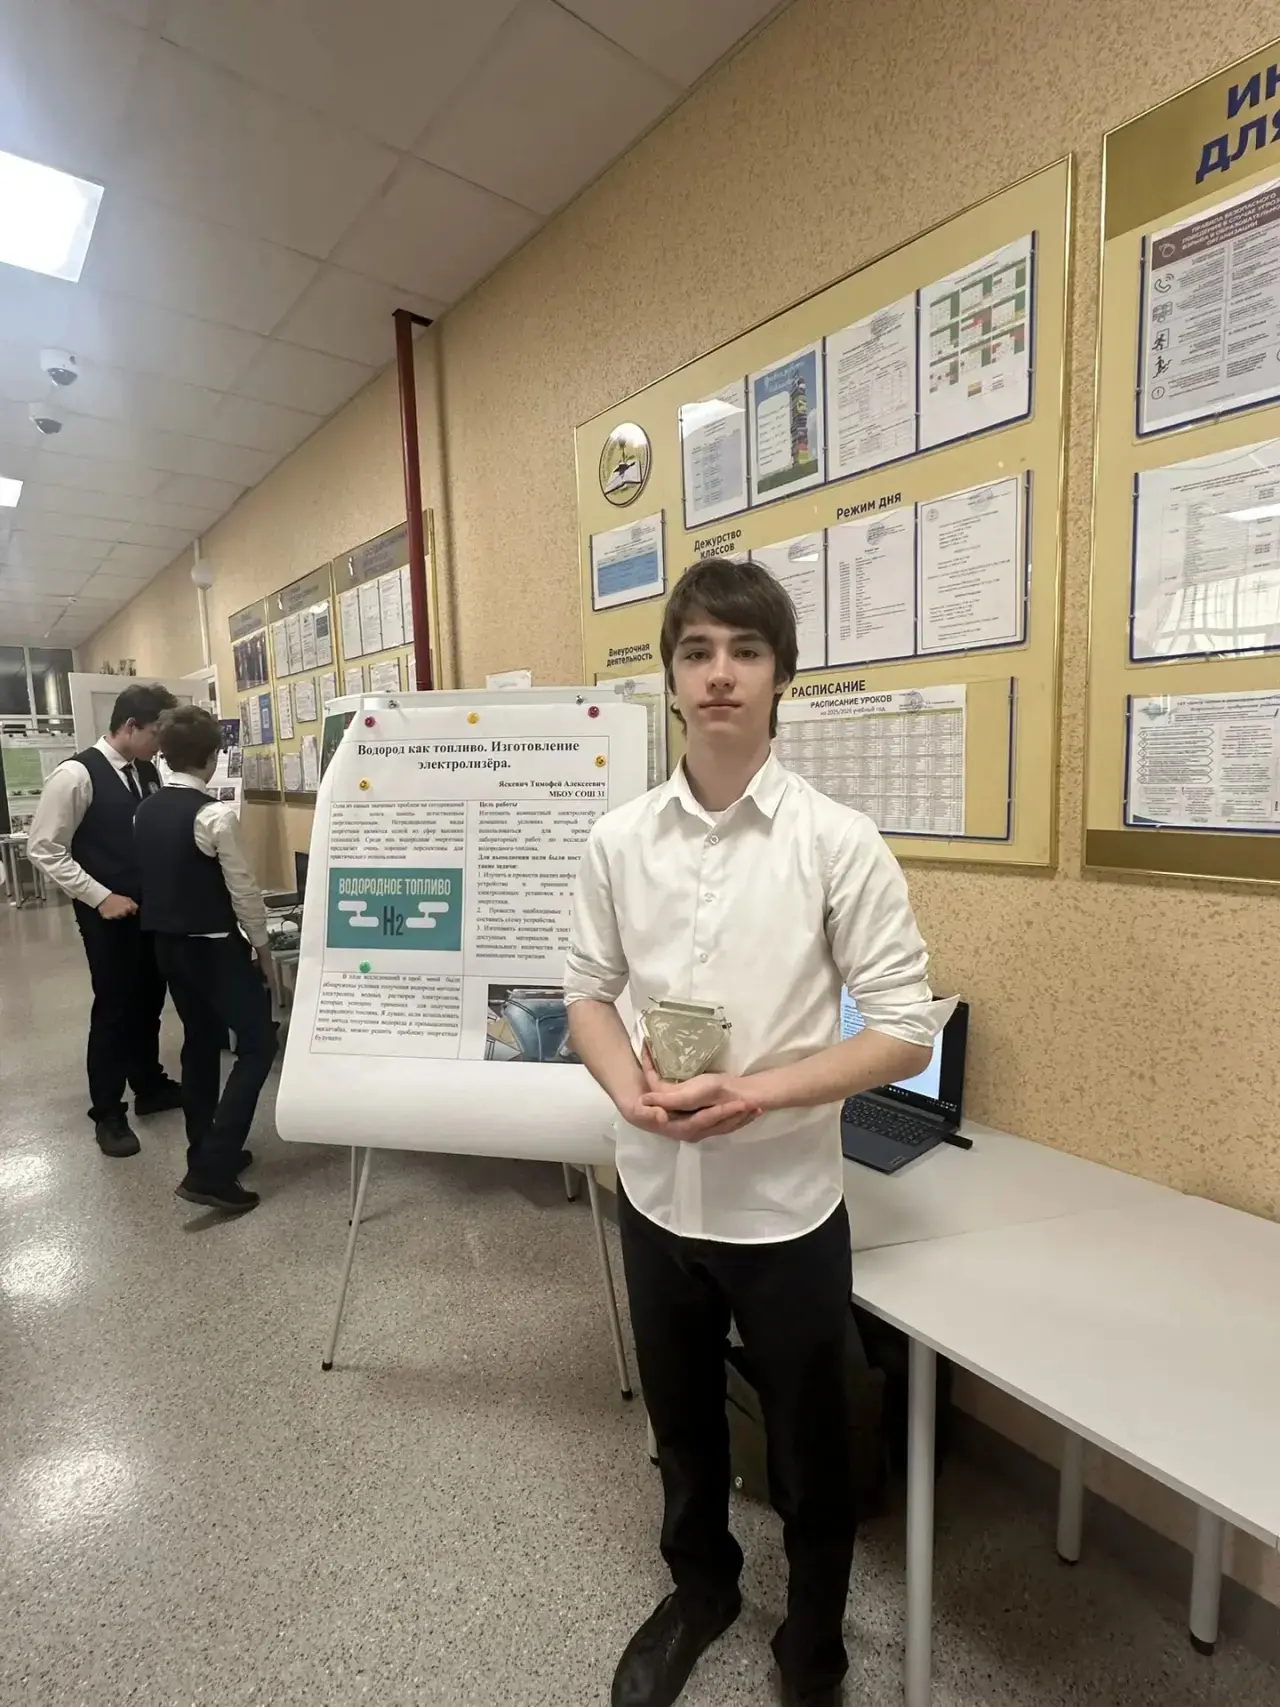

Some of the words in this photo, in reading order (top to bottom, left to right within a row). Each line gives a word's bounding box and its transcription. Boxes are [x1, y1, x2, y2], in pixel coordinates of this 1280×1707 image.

[836, 499, 875, 520] Режим
[879, 492, 902, 508] дня
[694, 529, 742, 552] Дежурство
[700, 542, 735, 560] классов
[609, 644, 649, 657] Внеурочная
[607, 653, 653, 667] деятельность
[792, 680, 866, 697] РАСПИСАНИЕ
[810, 698, 858, 708] РАСПИСАНИЕ
[860, 695, 892, 704] УРОКОВ
[358, 744, 405, 757] Водород
[408, 744, 429, 753] как
[433, 744, 487, 754] топливо.
[491, 741, 579, 752] Изготовление
[418, 758, 511, 772] электролизёра.
[530, 780, 562, 788] Тимофей
[338, 878, 402, 896] ВОДОРОДНОЕ
[405, 878, 451, 896] ТОПЛИВО
